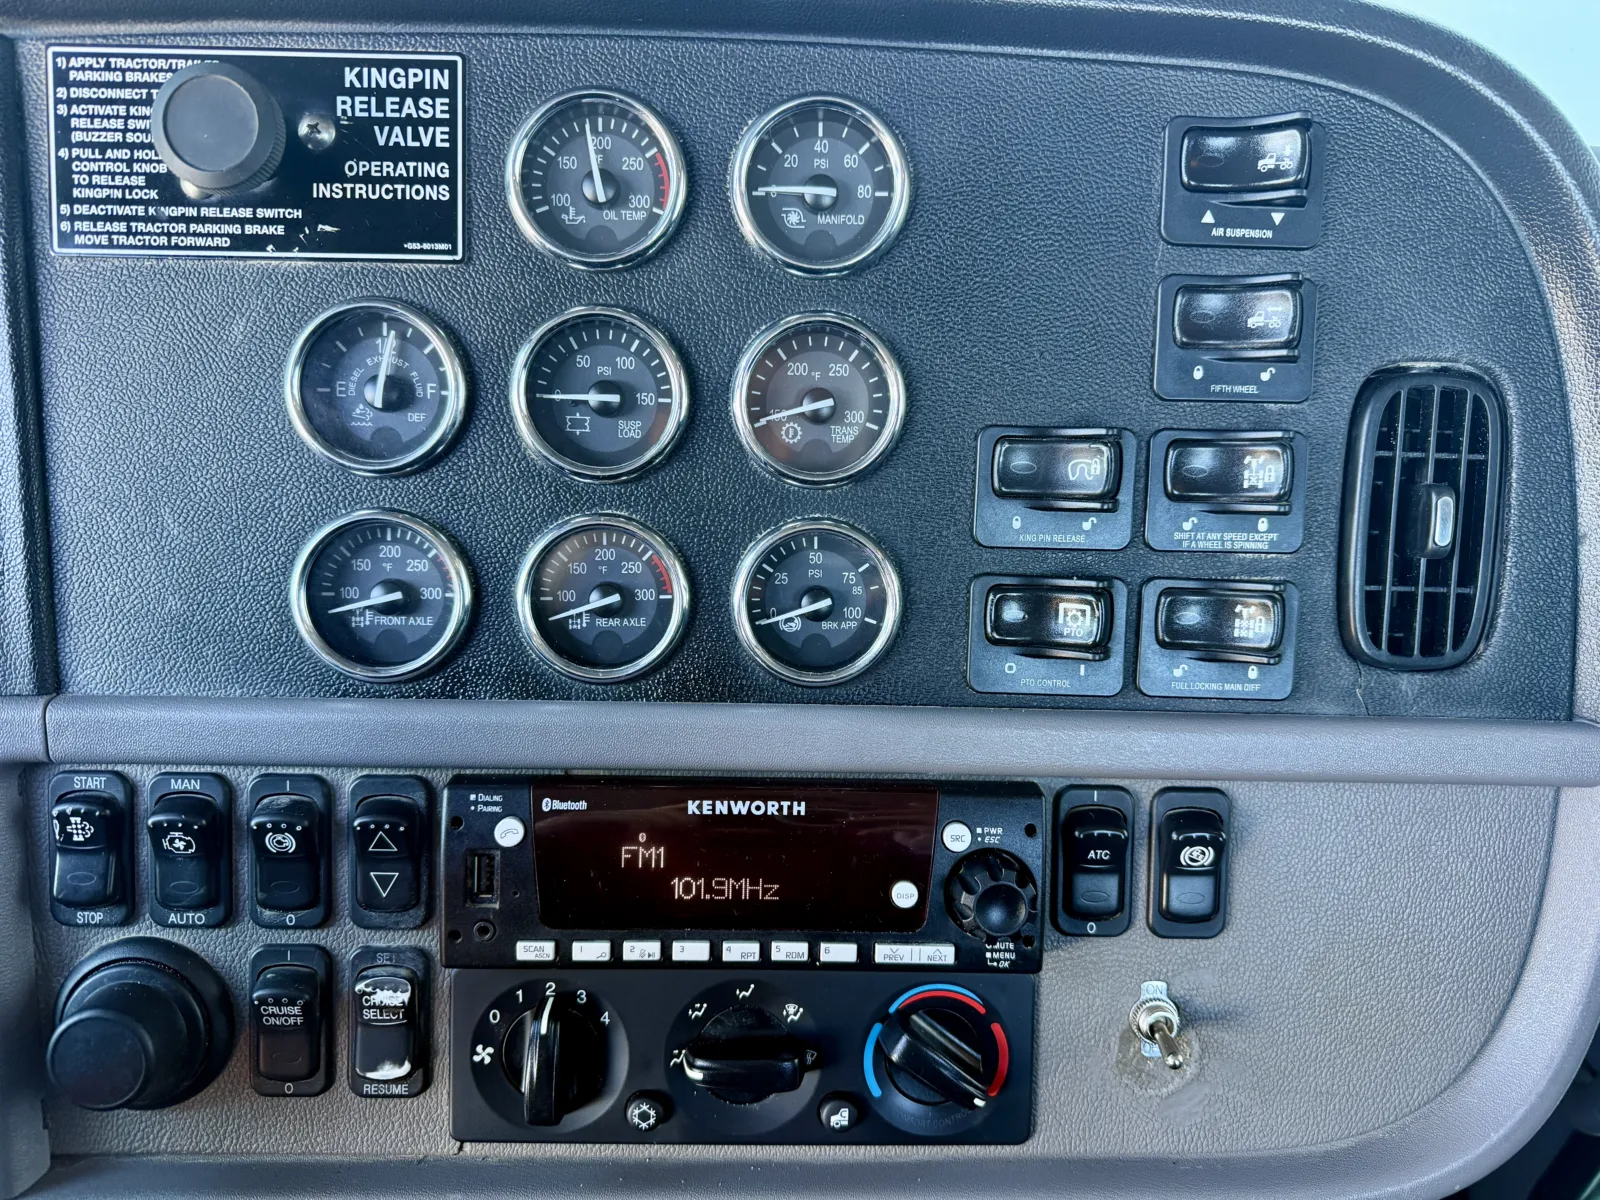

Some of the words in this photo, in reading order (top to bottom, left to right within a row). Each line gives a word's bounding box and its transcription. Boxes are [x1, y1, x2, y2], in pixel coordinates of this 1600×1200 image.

[56, 58, 66, 69] 1)
[68, 57, 107, 68] APPLY
[69, 72, 122, 82] PARKING
[344, 67, 450, 90] KINGPIN
[56, 87, 67, 99] 2)
[70, 88, 148, 99] DISCONNECT
[56, 104, 68, 116] 3)
[70, 104, 127, 116] ACTIVATE
[336, 96, 450, 119] RELEASE
[71, 118, 125, 129] RELEASE
[71, 132, 123, 142] (BUZZER
[374, 126, 450, 147] VALVE
[814, 140, 829, 153] 40
[58, 149, 68, 160] 4)
[72, 148, 102, 159] PULL
[105, 149, 131, 160] AND
[558, 156, 577, 170] 150
[622, 158, 644, 171] 250
[784, 154, 798, 168] 20
[814, 159, 829, 169] PSI
[844, 154, 859, 168] 60
[72, 162, 130, 173] CONTROL
[133, 162, 167, 173] KNOB
[344, 161, 450, 179] OPERATING
[72, 174, 90, 185] TO
[92, 175, 146, 185] RELEASE
[72, 188, 122, 199] KINGPIN
[126, 188, 159, 200] LOCK
[312, 183, 450, 201] INSTRUCTIONS
[858, 186, 872, 199] 80
[551, 194, 571, 207] 100
[629, 195, 650, 208] 300
[60, 205, 70, 216] 5)
[74, 205, 145, 216] DEACTIVATE
[200, 207, 253, 218] RELEASE
[256, 208, 302, 219] SWITCH
[603, 210, 618, 221] OIL
[621, 211, 647, 221] TEMP
[818, 214, 865, 225] MANIFOLD
[60, 222, 71, 233] 6)
[74, 222, 127, 232] RELEASE
[130, 222, 187, 233] TRACTOR
[190, 224, 242, 234] PARKING
[245, 225, 285, 235] BRAKE
[1211, 228, 1224, 237] AIR
[1226, 228, 1273, 239] SUSPENSION
[74, 235, 109, 246] MOVE
[111, 236, 168, 246] TRACTOR
[171, 236, 230, 247] FORWARD
[576, 356, 591, 368] 50
[616, 357, 635, 369] 100
[597, 366, 612, 376] PSI
[787, 363, 808, 376] 200
[829, 364, 850, 377] 250
[336, 382, 346, 397] E
[410, 372, 424, 398] FLUID
[427, 383, 437, 399] F
[1210, 385, 1232, 393] FIFTH
[1232, 385, 1259, 394] WHEEL
[636, 393, 655, 406] 150
[408, 413, 427, 422] DEF
[844, 411, 864, 423] 300
[618, 420, 642, 430] SUSP
[830, 426, 859, 436] TRANS
[618, 429, 642, 439] LOAD
[832, 435, 855, 444] TEMP
[1020, 534, 1037, 542] KING
[1038, 534, 1051, 542] PIN
[1053, 535, 1085, 543] RELEASE
[1174, 532, 1196, 540] SHIFT
[1196, 533, 1206, 541] AT
[1207, 533, 1222, 541] ANY
[1223, 533, 1248, 541] SPEED
[1248, 533, 1279, 541] EXCEPT
[1197, 541, 1223, 549] WHEEL
[1233, 542, 1269, 550] SPINNING
[379, 546, 401, 558] 200
[595, 549, 616, 561] 200
[809, 553, 823, 564] 50
[351, 559, 371, 571] 150
[406, 560, 429, 572] 250
[568, 563, 587, 574] 150
[622, 562, 642, 574] 250
[775, 573, 789, 584] 25
[808, 569, 823, 578] PSI
[842, 572, 856, 584] 75
[340, 587, 359, 599] 100
[420, 588, 442, 600] 300
[557, 590, 576, 602] 100
[635, 589, 655, 601] 300
[852, 586, 863, 595] 85
[843, 607, 862, 619] 100
[375, 617, 406, 626] FRONT
[408, 617, 434, 626] AXLE
[596, 618, 621, 627] REAR
[622, 618, 647, 627] AXLE
[822, 622, 838, 630] BRK
[841, 622, 858, 630] APP
[1064, 628, 1084, 637] PTO
[1021, 679, 1034, 687] PTO
[1037, 680, 1071, 688] CONTROL
[1172, 682, 1189, 690] FULL
[1191, 683, 1222, 691] LOCKING
[1244, 684, 1261, 692] DIFF
[74, 777, 107, 789] START
[171, 779, 200, 790] MAN
[552, 800, 588, 810] Bluetooth
[688, 800, 806, 816] KENWORTH
[984, 827, 1003, 835] PWR
[950, 834, 966, 843] SRC
[984, 836, 1001, 844] ESC
[621, 847, 664, 869] FM1
[1088, 850, 1111, 860] ATC
[671, 878, 780, 900] 101.9MHz
[76, 912, 104, 924] STOP
[168, 914, 205, 924] AUTO
[740, 952, 757, 960] RPT
[883, 954, 905, 962] PREV
[927, 954, 947, 962] NEXT
[993, 952, 1016, 960] MENU
[546, 982, 556, 996] 2
[1146, 984, 1163, 994] ON
[516, 989, 523, 1004] 1
[576, 990, 587, 1004] 3
[261, 1006, 303, 1015] CRUISE
[363, 1008, 405, 1020] SELECT
[263, 1017, 304, 1026] ON/OFF
[600, 1011, 611, 1026] 4
[364, 1084, 409, 1095] RESUME
